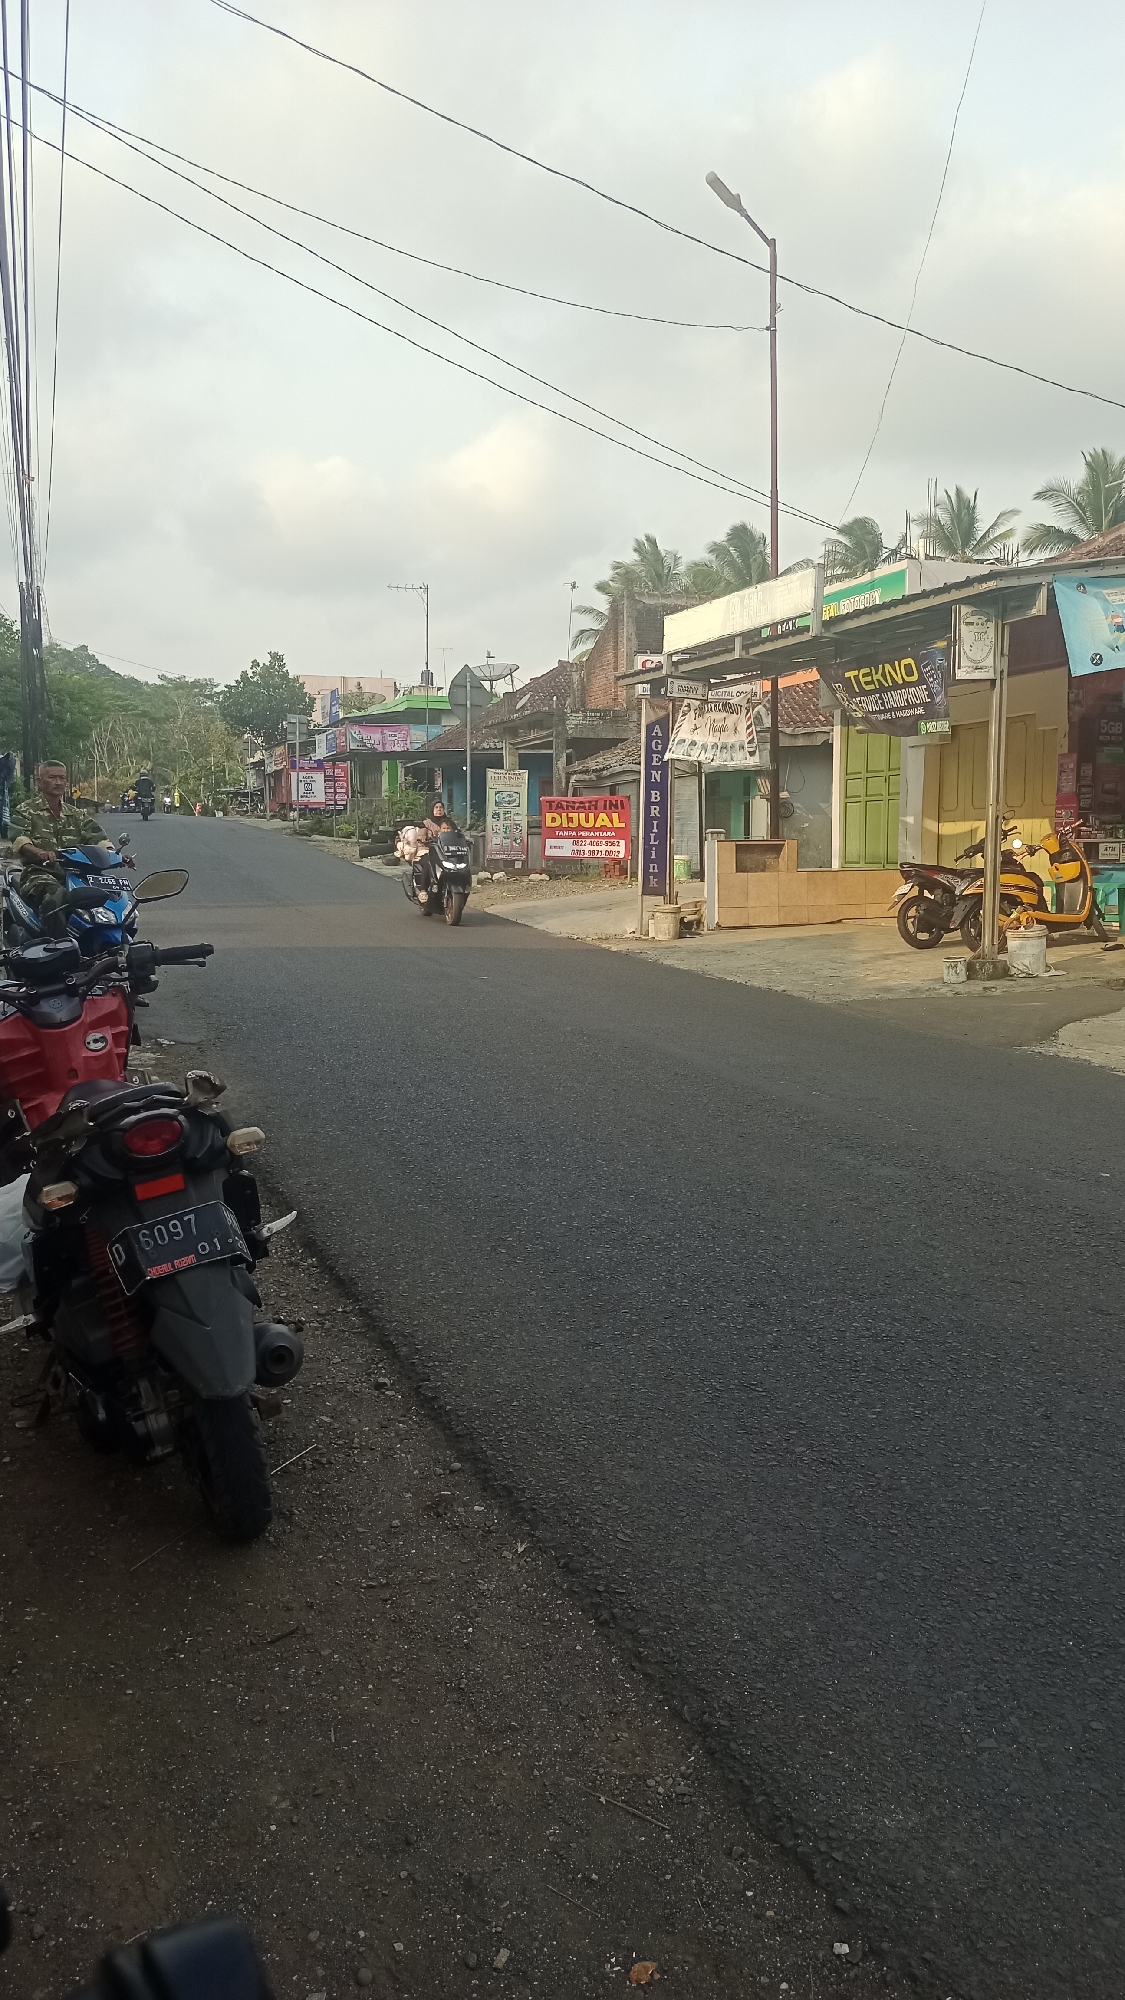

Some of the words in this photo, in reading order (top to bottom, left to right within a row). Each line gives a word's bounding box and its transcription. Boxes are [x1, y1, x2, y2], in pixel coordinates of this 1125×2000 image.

[743, 591, 763, 606] Agen
[743, 602, 772, 620] BRILink
[844, 657, 919, 693] TEKNO
[710, 690, 734, 698] DIGITAL
[881, 684, 931, 710] HANDPHONE
[896, 706, 926, 719] HARDWARE
[1100, 720, 1123, 734] 5GB
[651, 724, 663, 783] AGEN
[546, 800, 599, 811] TANAH
[603, 799, 625, 811] INI
[545, 812, 626, 828] DIJUAL
[648, 790, 661, 888] BRILink
[112, 1243, 126, 1267] D
[138, 1213, 197, 1251] 6097
